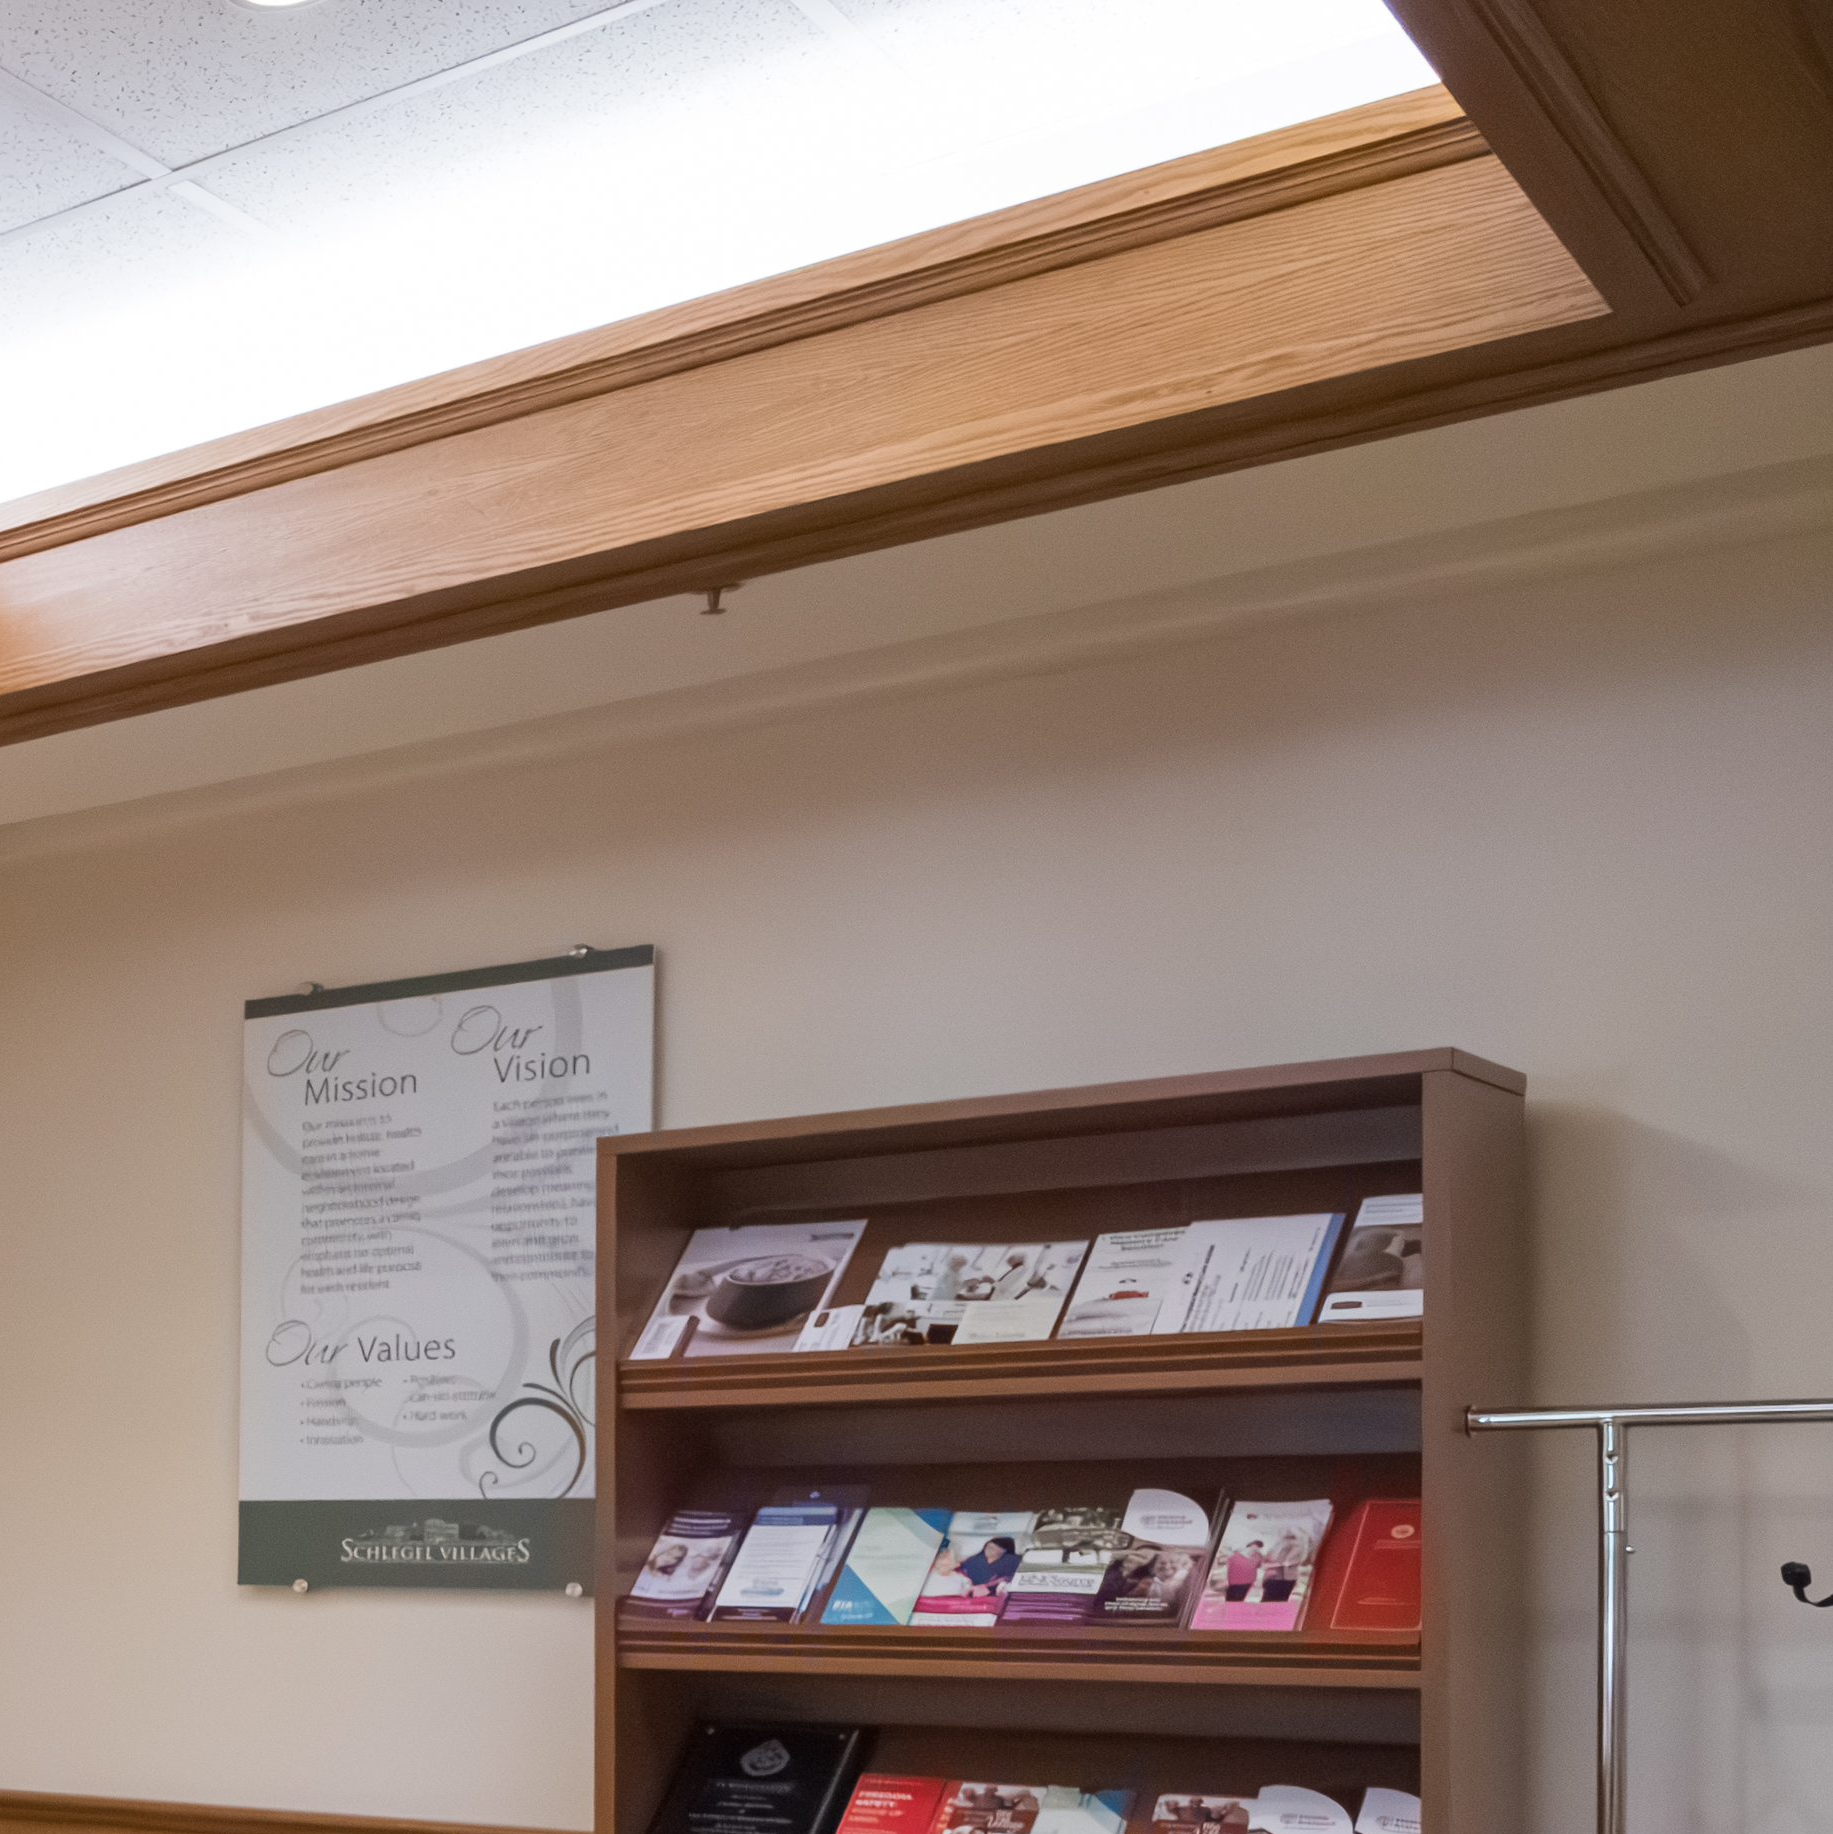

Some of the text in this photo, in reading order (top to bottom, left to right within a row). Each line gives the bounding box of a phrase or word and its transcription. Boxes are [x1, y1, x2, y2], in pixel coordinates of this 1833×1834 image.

[451, 1005, 543, 1056] Our
[267, 1029, 351, 1078] Our
[493, 1052, 591, 1084] Vision
[304, 1071, 418, 1107] Mission
[265, 1319, 457, 1367] Our Values
[340, 1537, 531, 1564] SCHLEGEL VILLAGES
